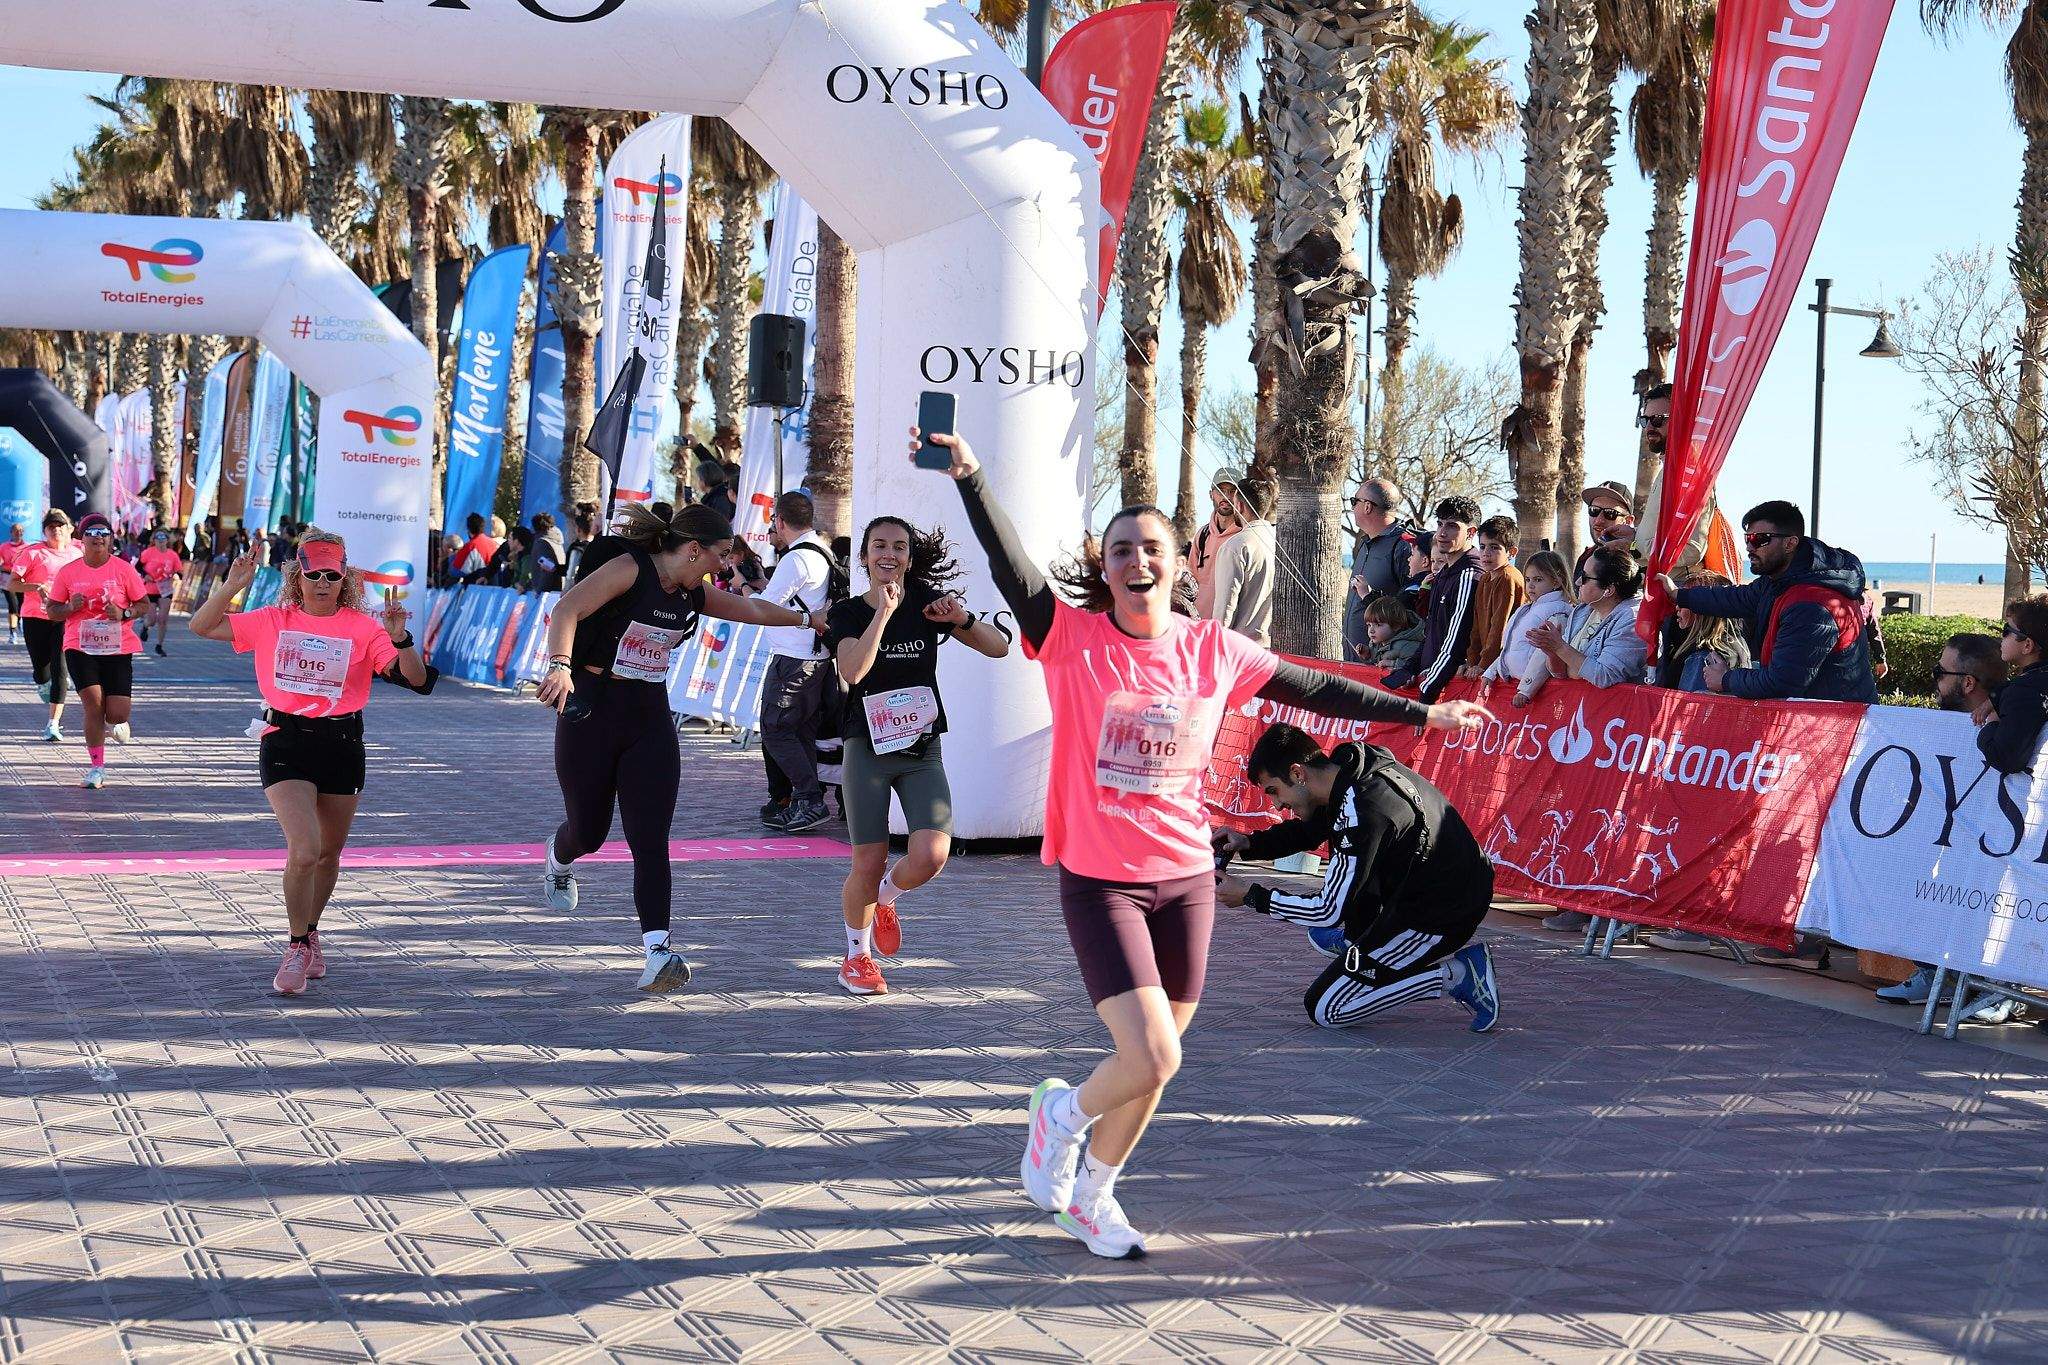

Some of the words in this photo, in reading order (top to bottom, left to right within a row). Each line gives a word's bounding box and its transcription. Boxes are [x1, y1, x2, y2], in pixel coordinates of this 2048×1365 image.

[826, 64, 1009, 110] OYSHO
[101, 290, 204, 307] TotalEnergies
[920, 345, 1084, 387] OYSHO
[451, 330, 502, 458] Marlene
[341, 451, 422, 468] TotalEnergies
[337, 510, 418, 523] totalenergies.es
[653, 609, 677, 620] OYSHO
[639, 647, 662, 660] 016
[298, 659, 326, 672] 016
[892, 712, 918, 727] 016
[1138, 740, 1177, 756] 016
[1594, 717, 1803, 794] Santander
[1105, 773, 1140, 787] OYSHO
